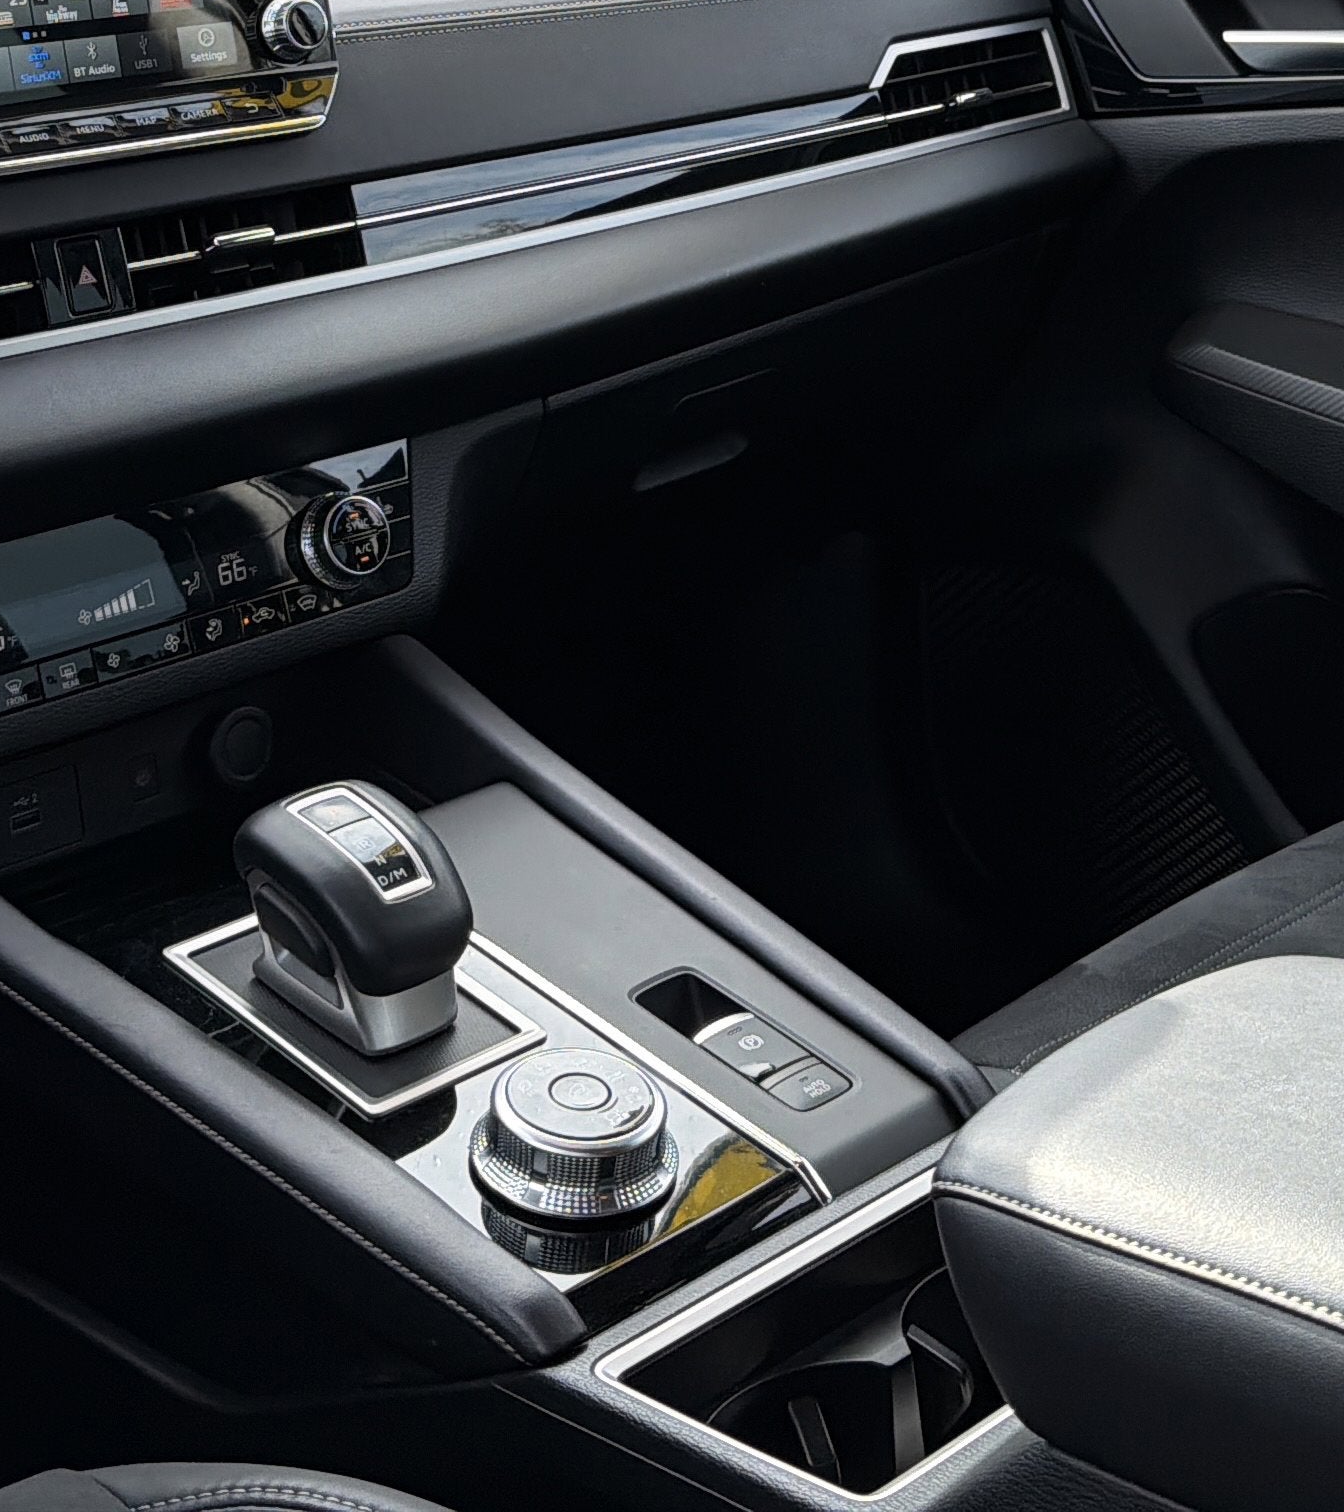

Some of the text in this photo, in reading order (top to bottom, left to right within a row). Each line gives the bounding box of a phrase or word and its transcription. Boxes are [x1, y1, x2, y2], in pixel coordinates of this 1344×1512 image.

[190, 49, 228, 63] Settings
[73, 63, 116, 77] BT Audio
[134, 59, 158, 70] USB1
[135, 115, 157, 127] MAP
[180, 108, 220, 121] CAMERA
[76, 123, 105, 135] MENU
[19, 132, 50, 144] AUDIO
[346, 517, 370, 534] SYNC
[355, 541, 373, 555] A/C
[217, 557, 247, 586] 66
[6, 692, 29, 707] FRONT
[376, 866, 408, 887] D/M
[803, 1079, 825, 1093] AUTO
[809, 1084, 831, 1098] HOLD
